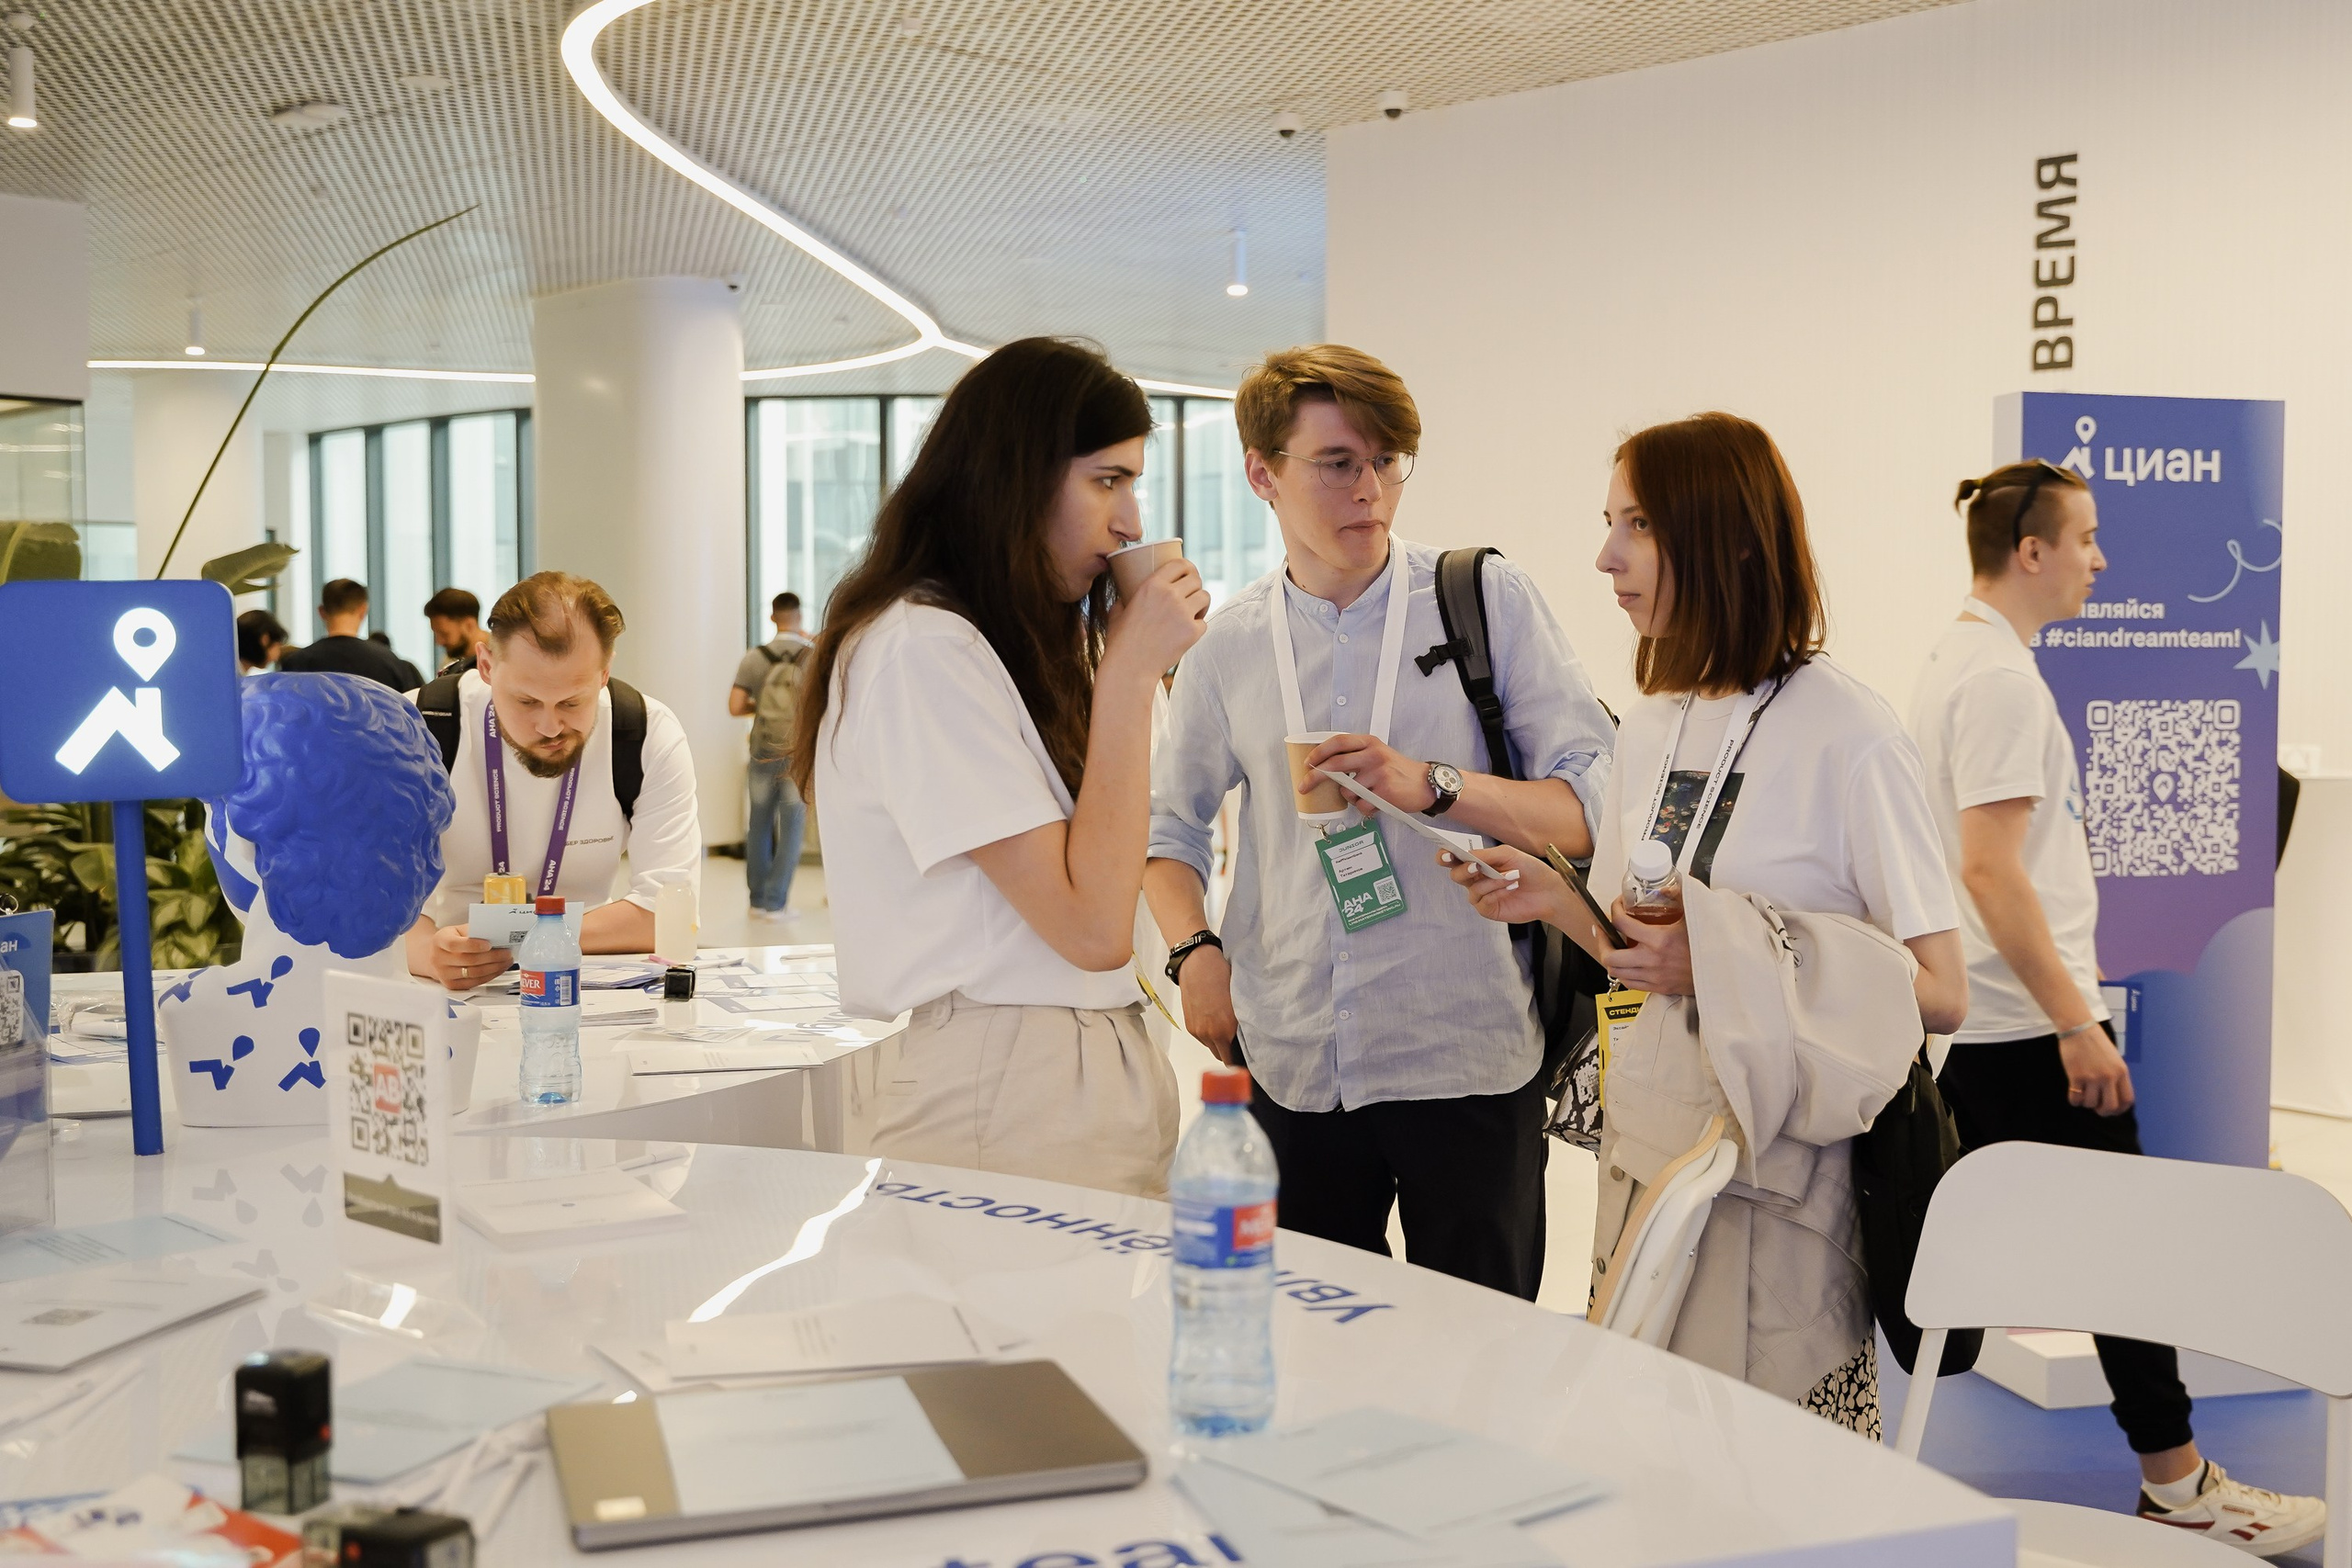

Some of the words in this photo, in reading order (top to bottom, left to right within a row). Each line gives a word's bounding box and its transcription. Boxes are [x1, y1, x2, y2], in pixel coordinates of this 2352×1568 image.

[2032, 152, 2078, 371] ВРЕМЯ
[2045, 626, 2242, 649] #ciandreamteam!
[1713, 739, 1735, 785] PRODUCT
[1641, 798, 1657, 841] PRODUCT
[1656, 753, 1670, 795] SCIENCE
[1696, 786, 1717, 829] SCIENCE
[558, 800, 570, 831] SCIENCE
[1338, 840, 1364, 853] JUNIOR
[0, 940, 18, 953] ан
[522, 977, 541, 988] EVER
